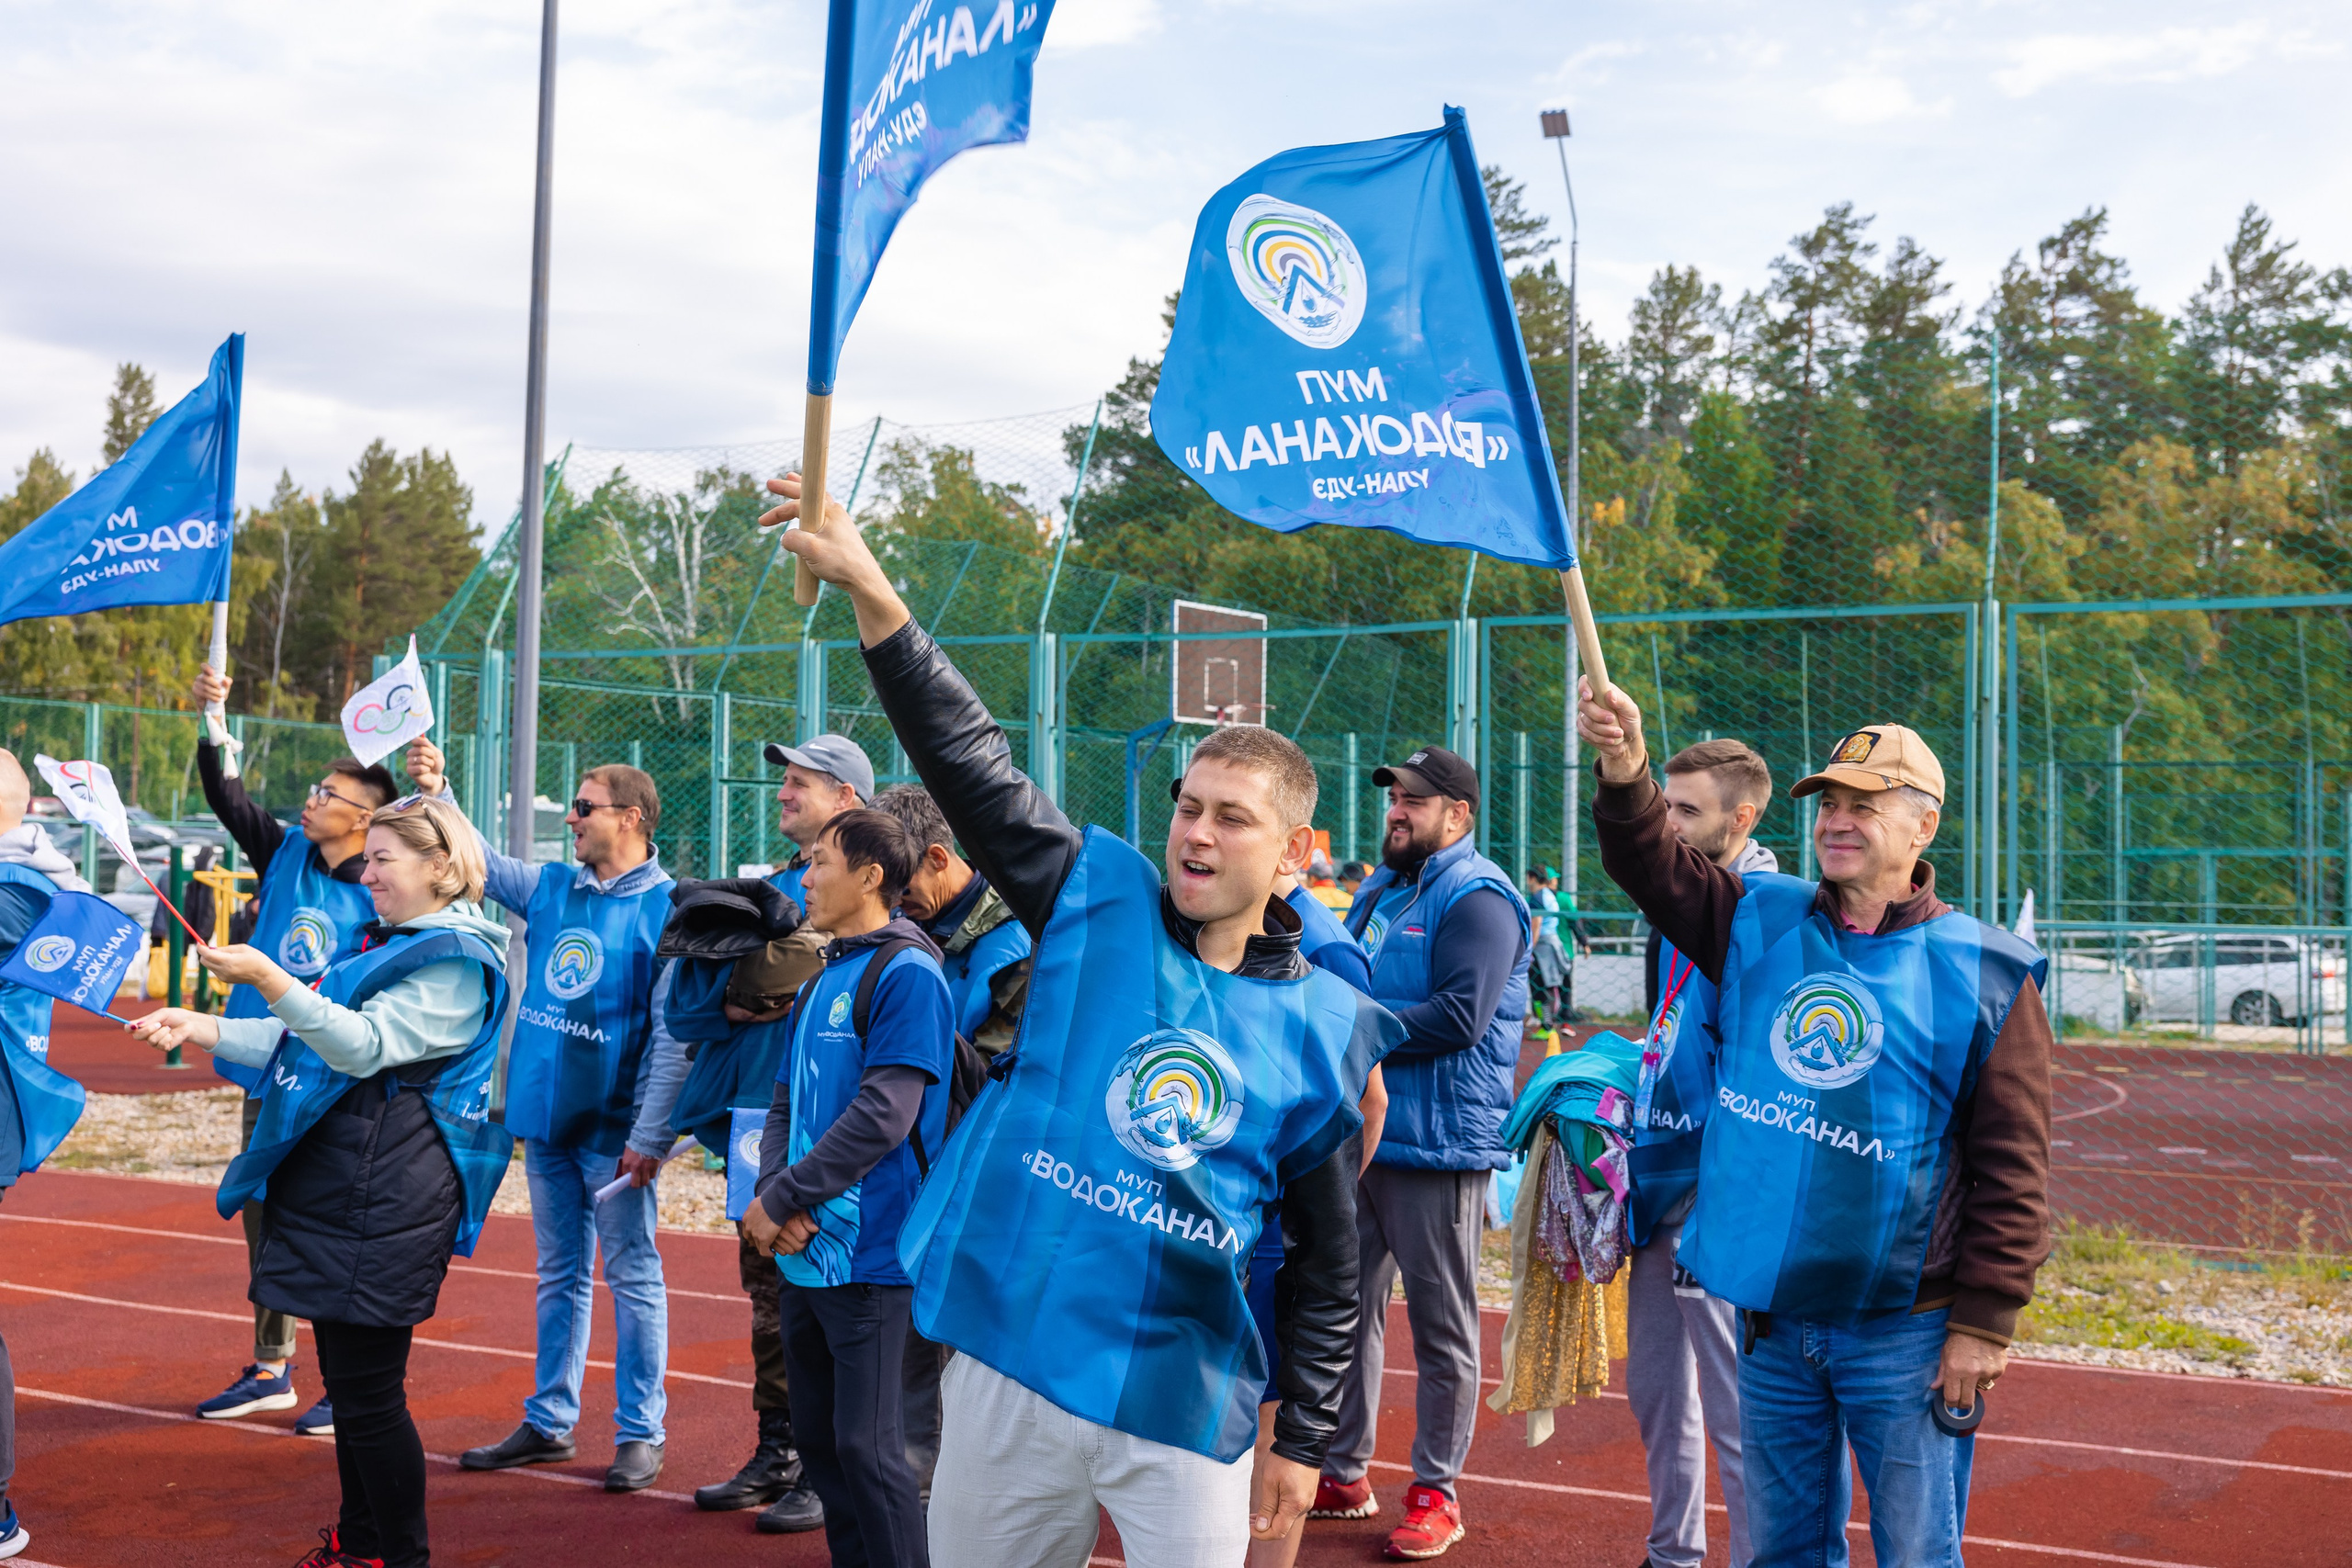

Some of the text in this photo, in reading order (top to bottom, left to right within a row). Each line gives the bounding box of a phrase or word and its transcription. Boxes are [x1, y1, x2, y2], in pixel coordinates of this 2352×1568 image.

[72, 944, 96, 972] МУП
[519, 1006, 612, 1043] ВОДОКАНАЛ»
[1777, 1090, 1816, 1112] МУП
[1717, 1086, 1895, 1163] ВОДОКАНАЛ»
[1115, 1168, 1163, 1197] МУП
[1022, 1149, 1245, 1255] «ВОДОКАНАЛ»
